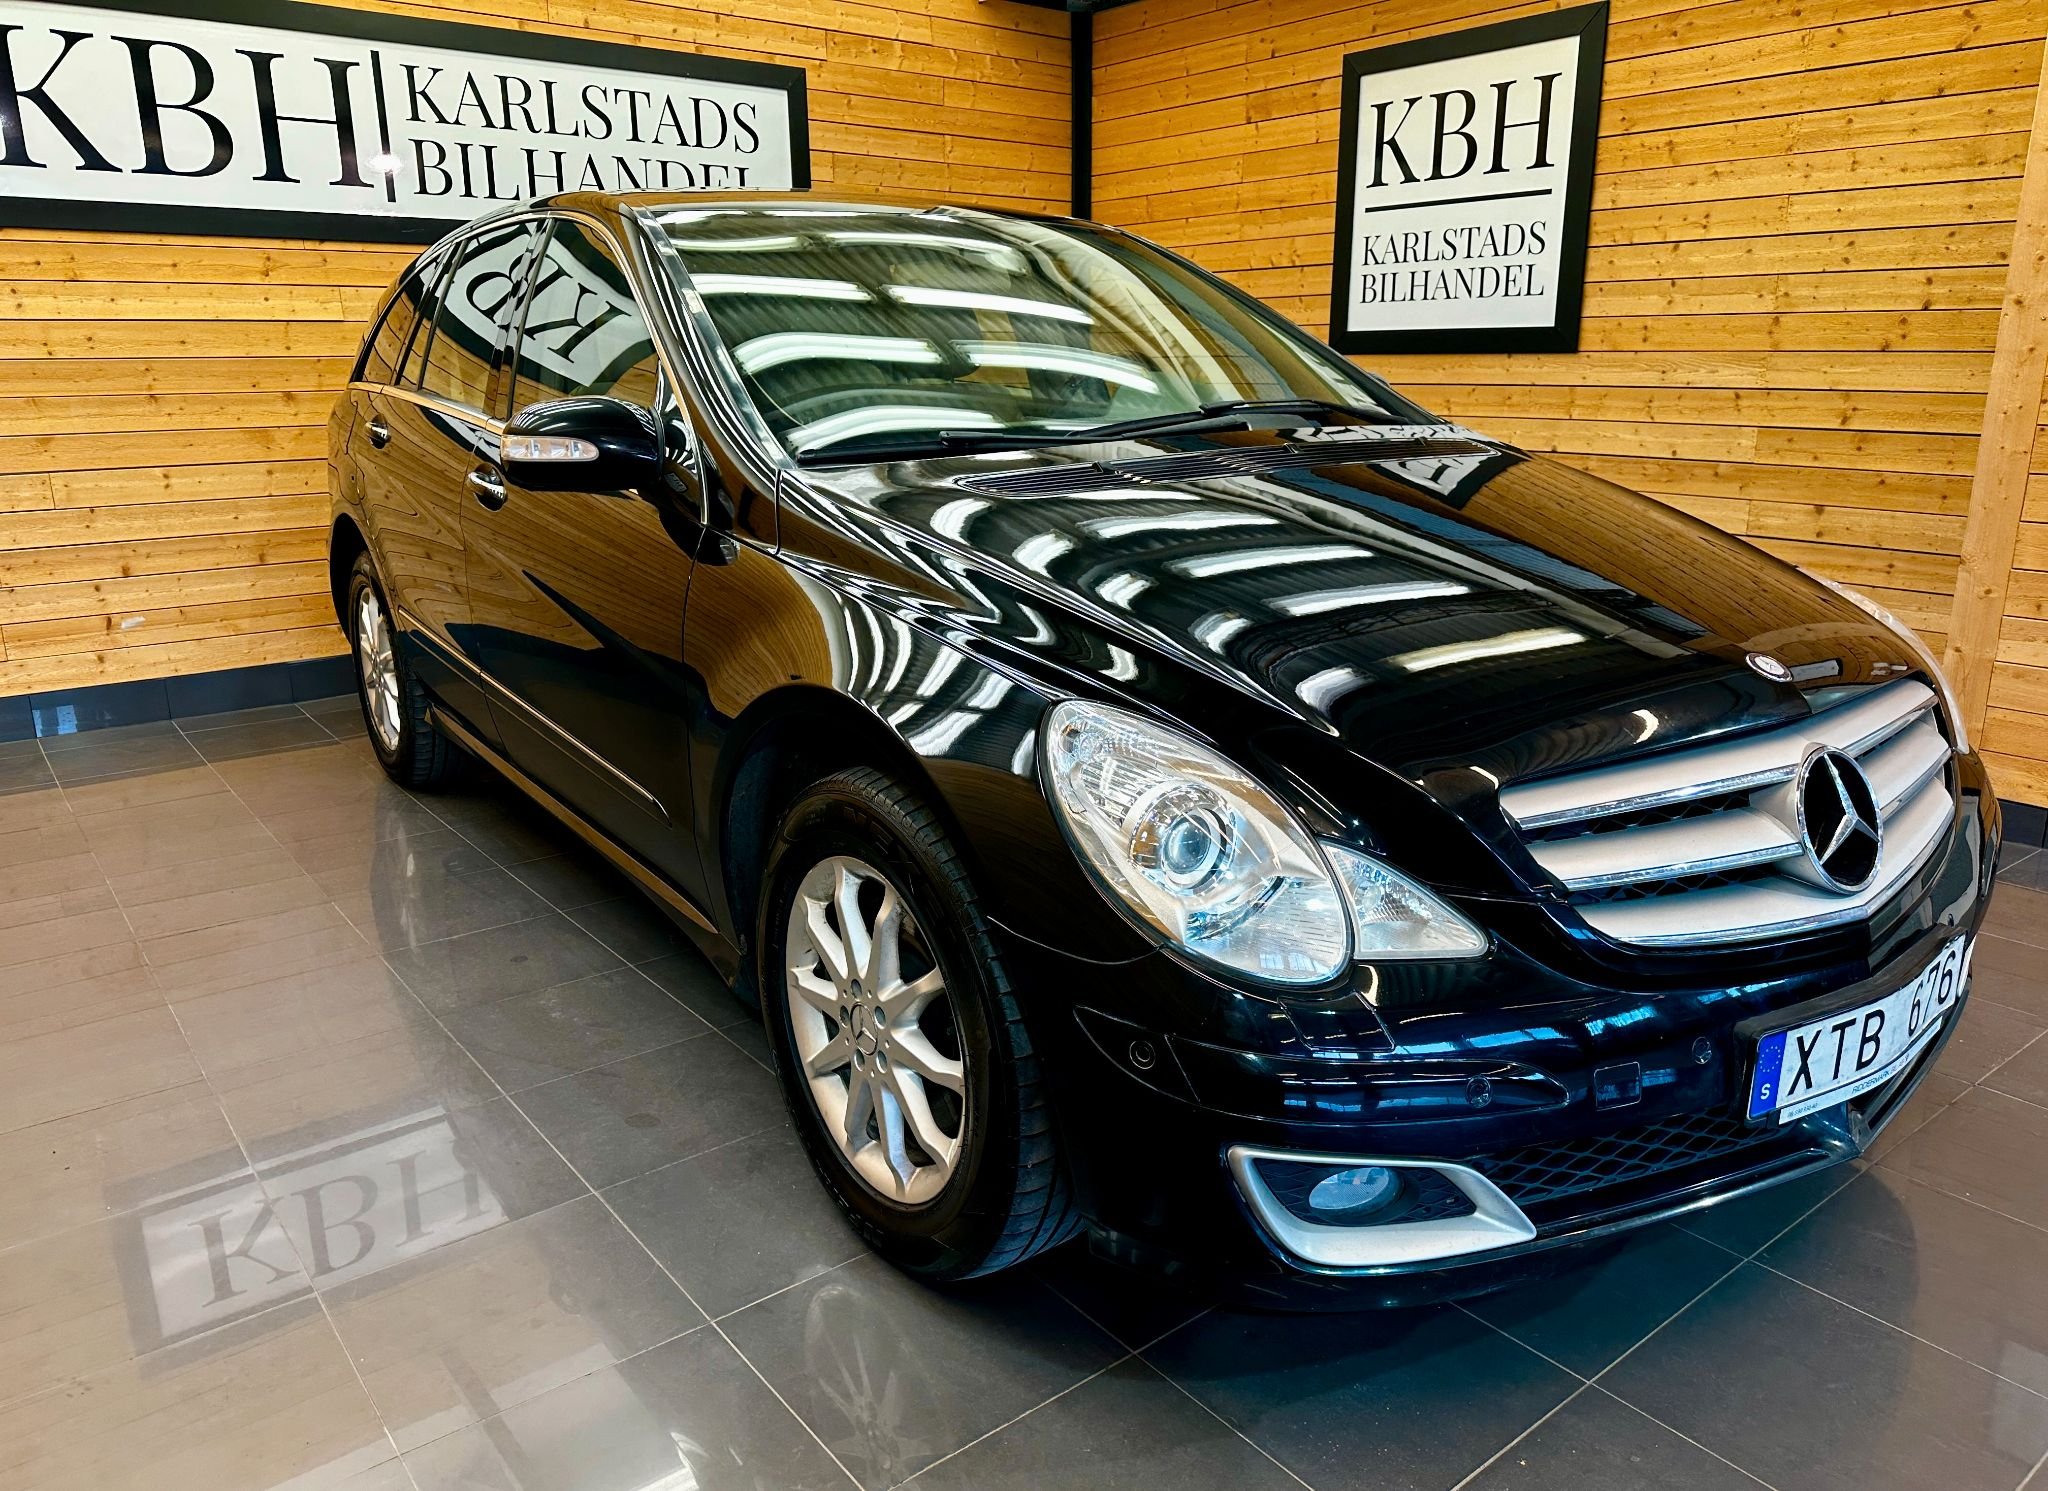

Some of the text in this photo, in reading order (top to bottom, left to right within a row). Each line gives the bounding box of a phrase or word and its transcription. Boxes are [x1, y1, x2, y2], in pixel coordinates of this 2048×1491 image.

[0, 24, 375, 188] KBH
[400, 64, 760, 154] KARLSTADS
[1366, 72, 1562, 189] KBH
[1360, 263, 1545, 304] BILHANDEL
[1362, 221, 1546, 266] KARLSTADS
[1788, 950, 1956, 1096] XTB 676
[1760, 1083, 1770, 1100] S
